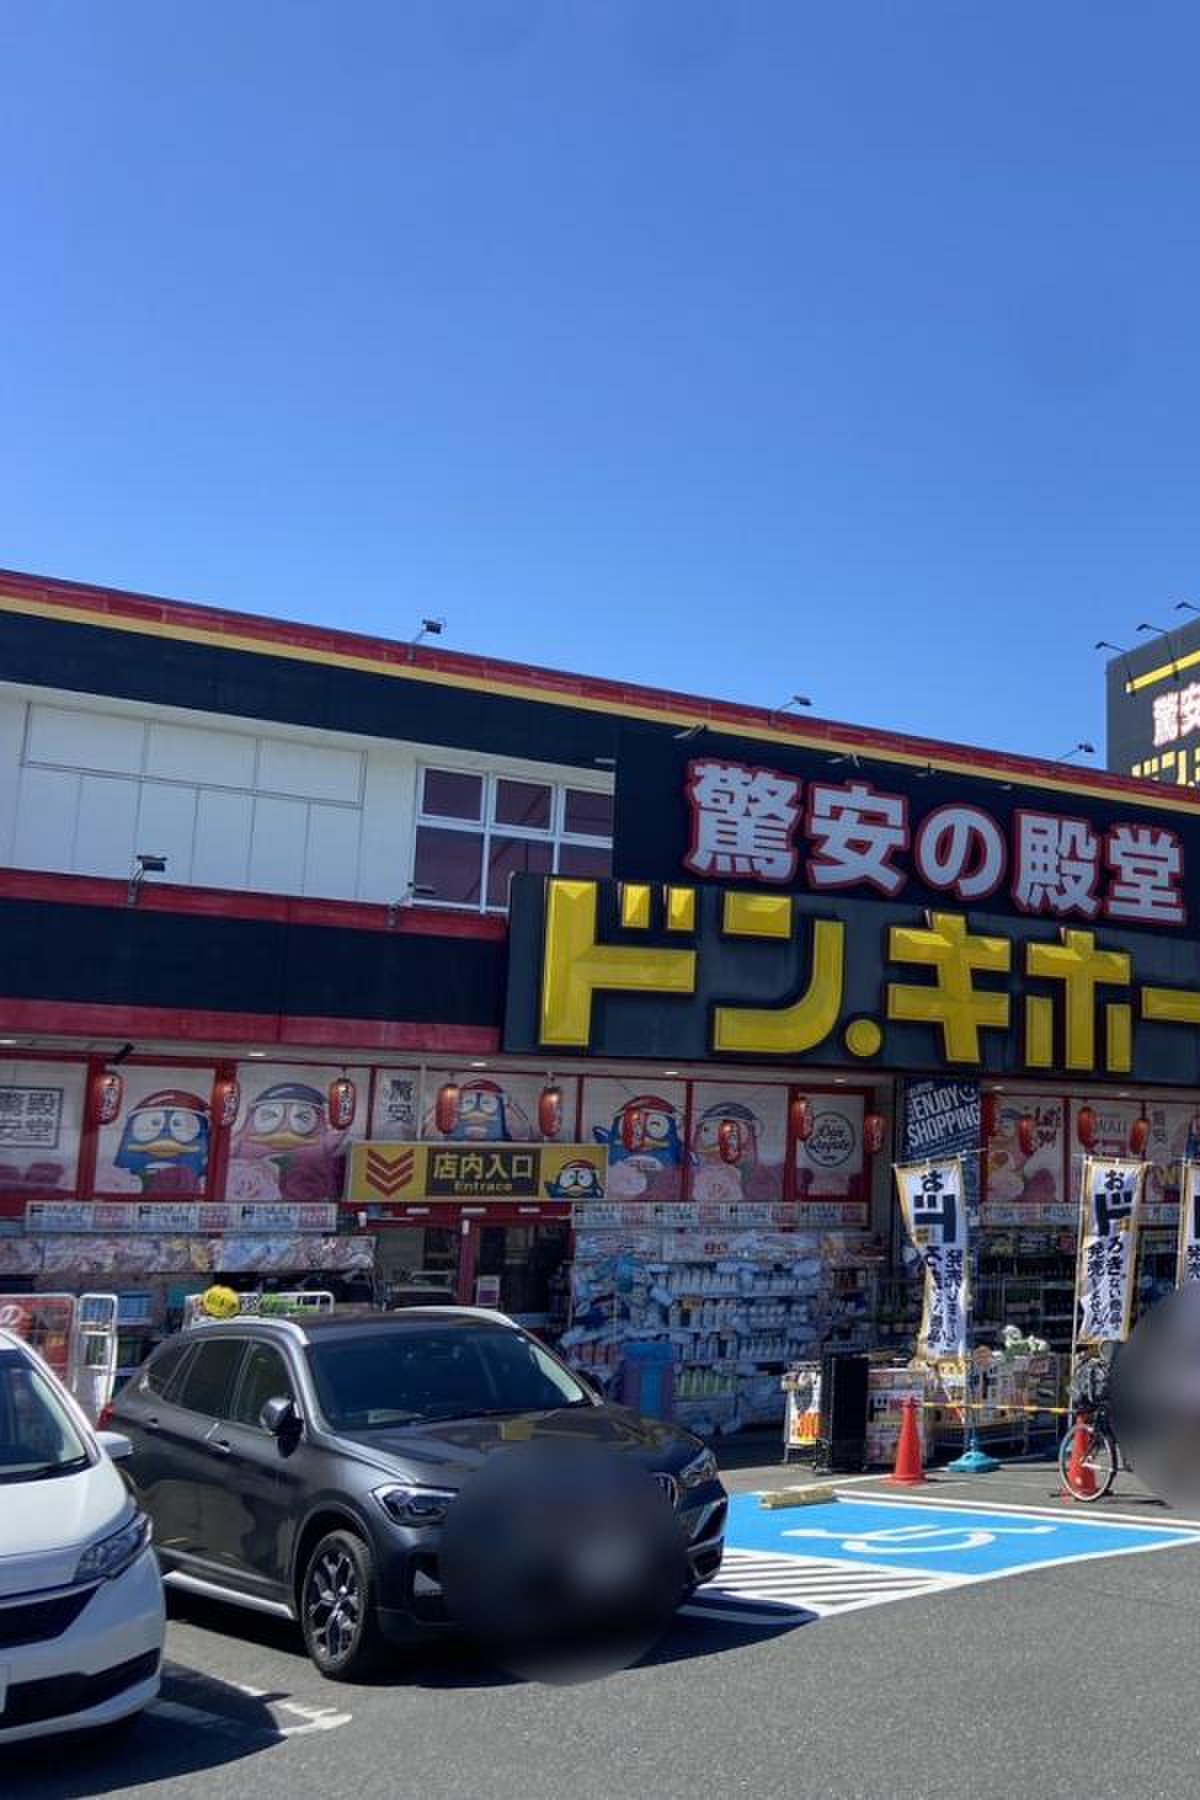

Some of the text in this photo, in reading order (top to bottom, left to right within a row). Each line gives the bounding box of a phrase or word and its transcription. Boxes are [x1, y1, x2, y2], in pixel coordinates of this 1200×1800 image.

[686, 759, 1185, 924] 驚安の殿堂
[911, 1085, 960, 1120] ENJOY
[907, 1103, 981, 1147] SHOPPING
[433, 1153, 532, 1178] 店内入口
